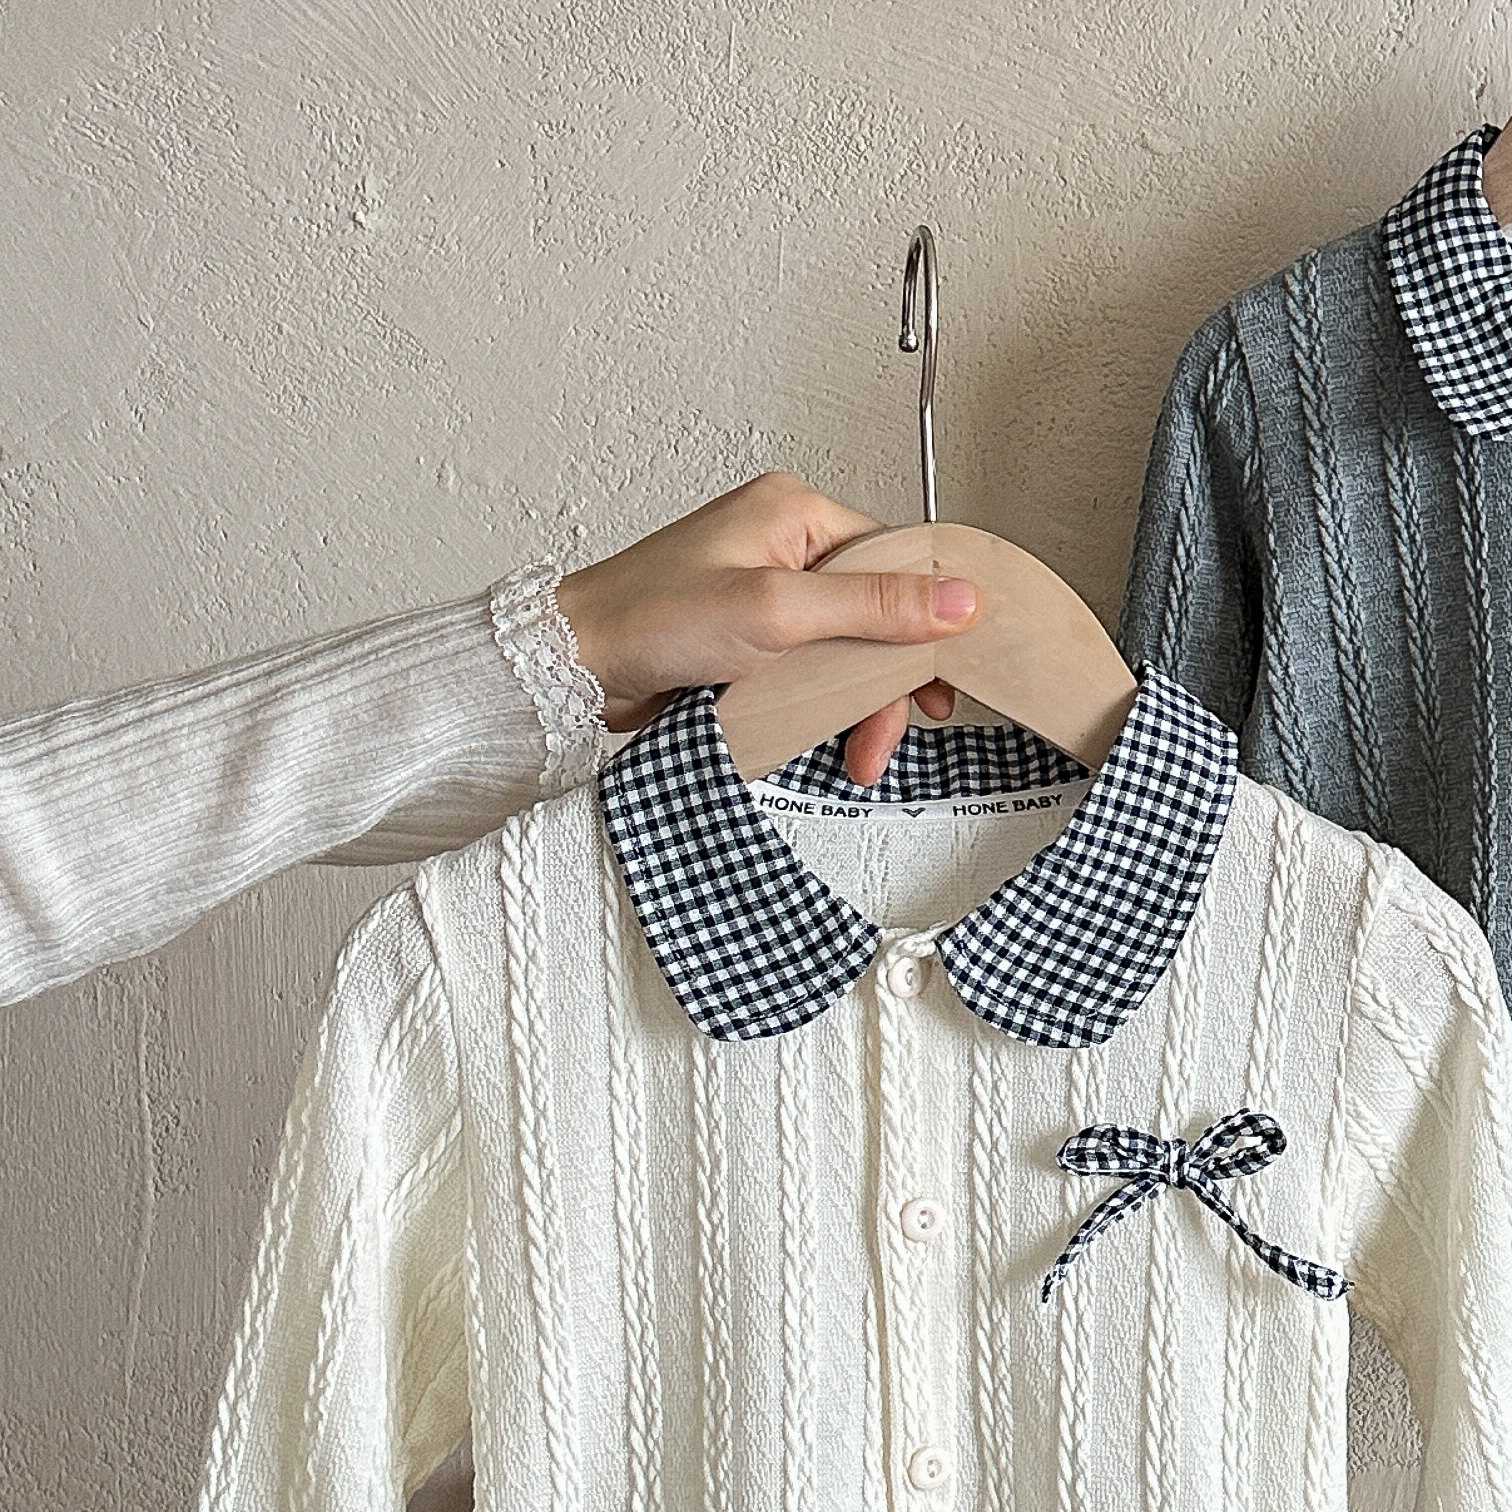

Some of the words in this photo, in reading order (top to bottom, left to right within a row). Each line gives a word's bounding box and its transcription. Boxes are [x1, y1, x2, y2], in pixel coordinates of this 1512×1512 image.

[759, 794, 816, 816] HONE
[821, 804, 874, 819] BABY
[952, 801, 1010, 818] HONE
[1014, 794, 1065, 812] BABY
